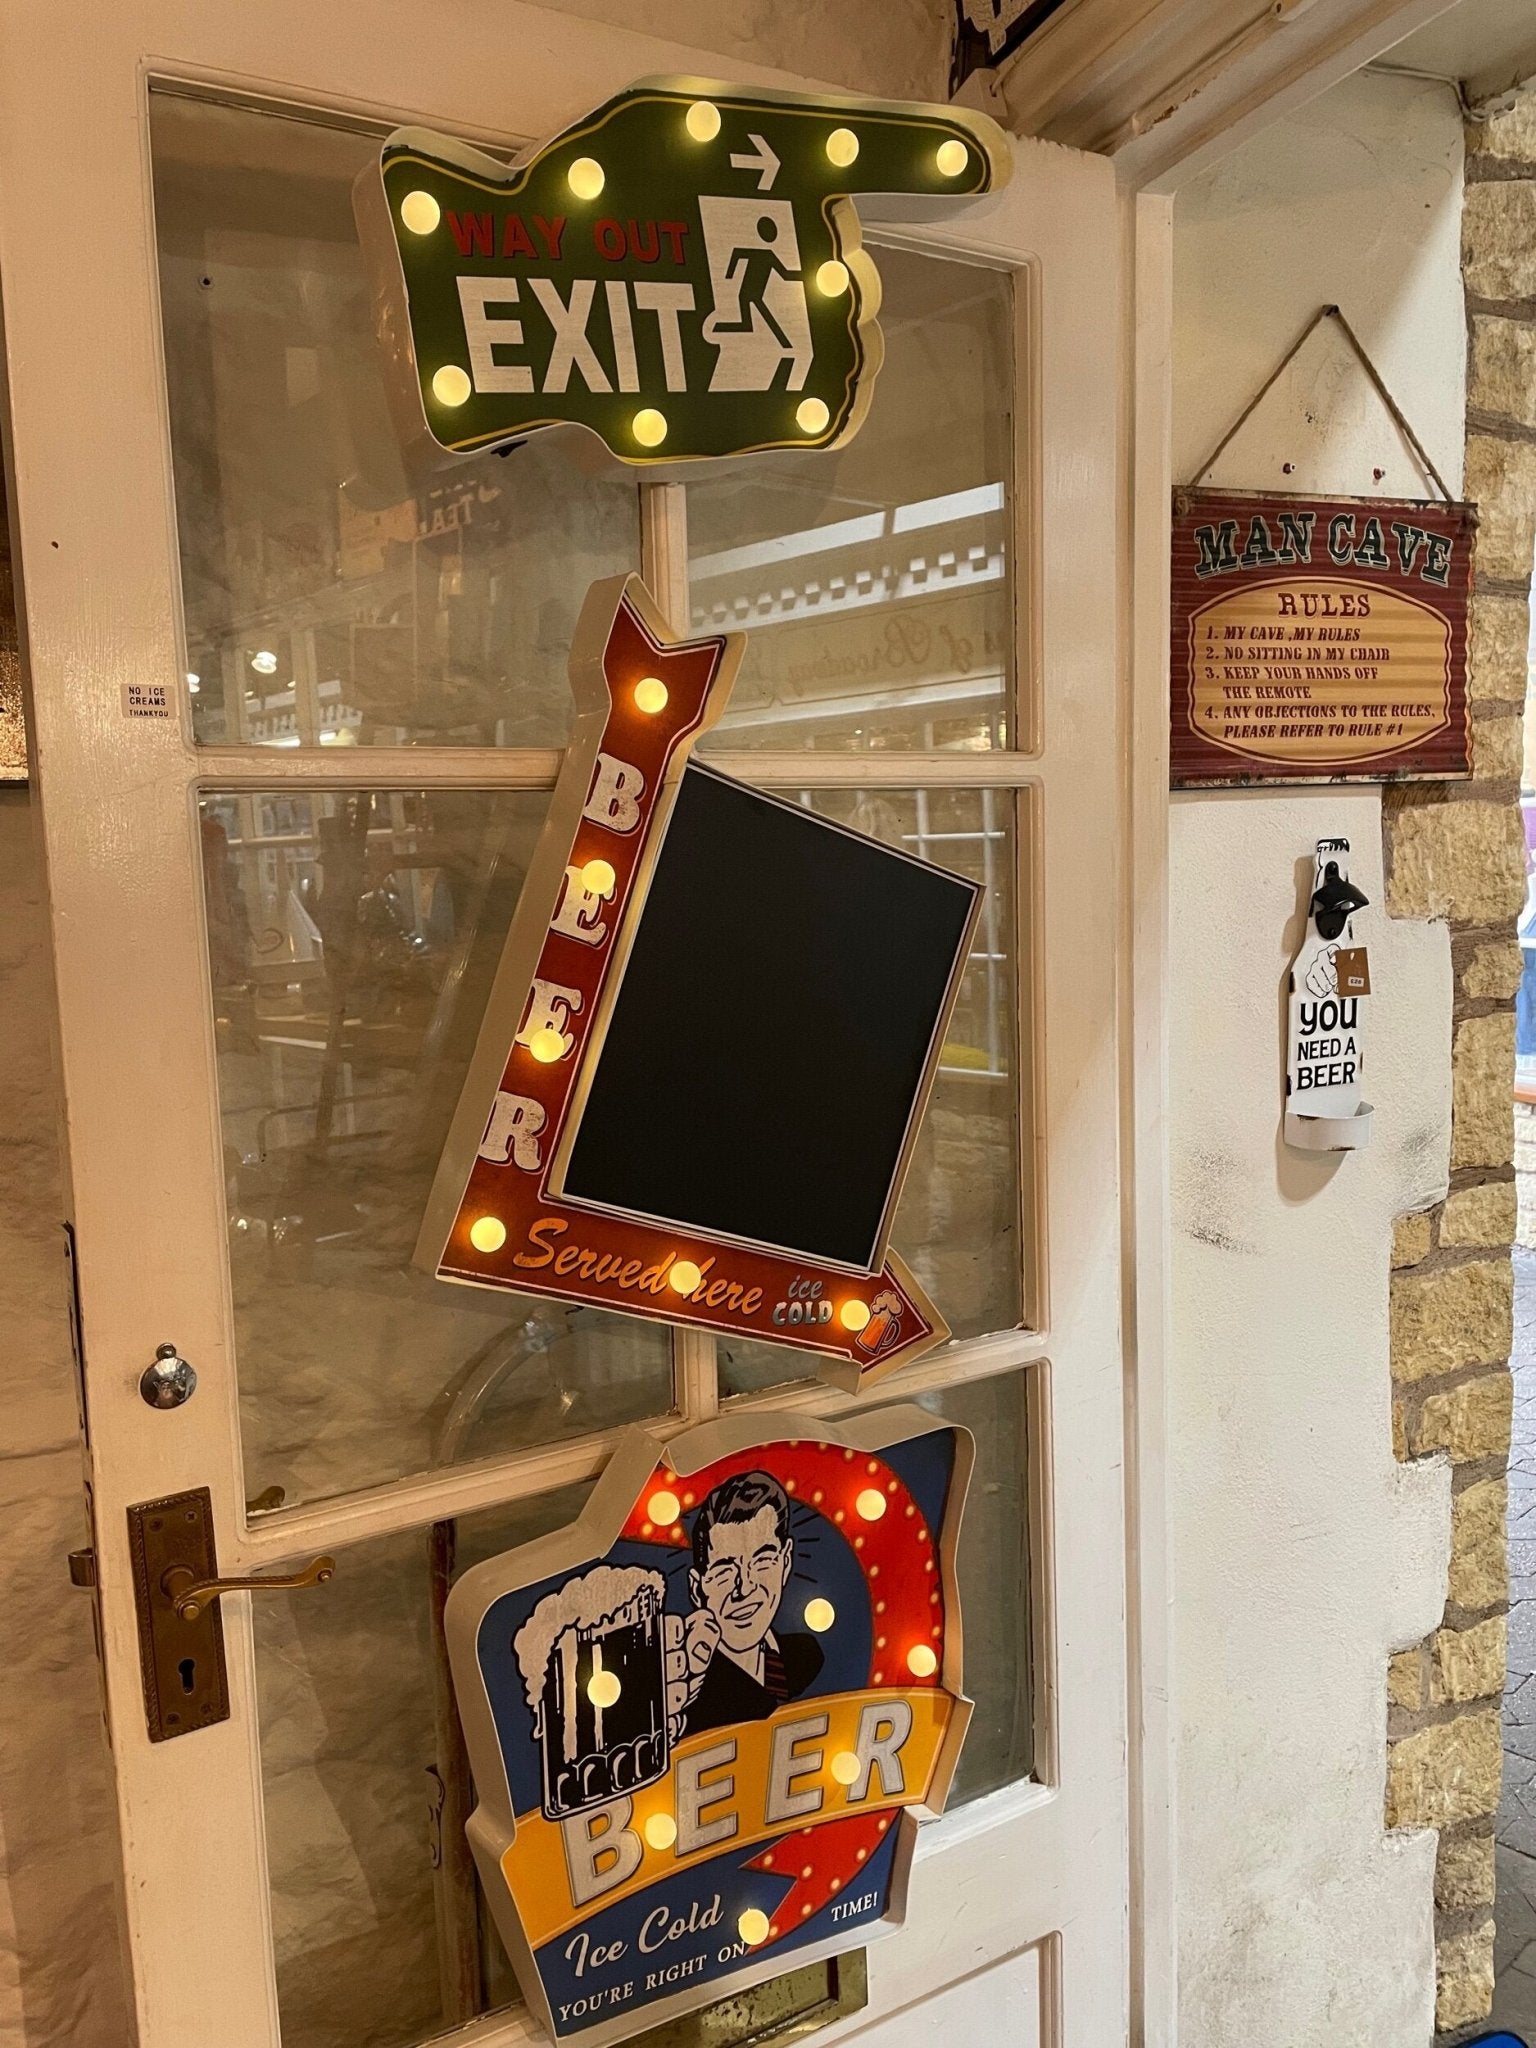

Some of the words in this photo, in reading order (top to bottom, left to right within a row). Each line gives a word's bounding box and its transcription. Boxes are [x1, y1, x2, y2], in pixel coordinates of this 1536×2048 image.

[446, 210, 566, 260] WAY
[593, 217, 690, 265] OUT
[457, 275, 697, 393] EXIT
[1194, 512, 1316, 580] MAN
[1327, 513, 1453, 588] CAVE
[1278, 592, 1371, 617] RULES
[1207, 626, 1219, 640] 1.
[1223, 626, 1246, 640] MY
[1318, 627, 1361, 641] RULES
[1205, 646, 1219, 659] 2.
[1224, 646, 1243, 660] NO
[1248, 647, 1302, 660] SITTING
[1307, 647, 1321, 660] IN
[1326, 647, 1345, 660] MY
[1350, 648, 1390, 660] CHAIR
[1205, 667, 1219, 679] 3.
[1223, 666, 1260, 679] KEEP
[1264, 667, 1302, 679] YOUR
[1305, 667, 1351, 680] HANDS
[1354, 667, 1378, 679] OFF
[128, 686, 141, 695] NO
[148, 687, 165, 696] ICE
[129, 696, 166, 706] CREAMS
[1223, 686, 1252, 698] THE
[1255, 686, 1312, 698] REMOTE
[1204, 706, 1218, 719] 4.
[1223, 706, 1252, 718] ANY
[1254, 705, 1337, 718] OBJECTIONS
[1340, 705, 1358, 718] TO
[1361, 704, 1388, 718] THE
[1391, 704, 1435, 718] RULES,
[1223, 725, 1277, 738] PLEASE
[1279, 724, 1324, 738] REFER
[1327, 724, 1345, 737] TO
[1348, 723, 1383, 737] RULE
[1297, 1038, 1341, 1061] NEED
[1344, 1036, 1357, 1056] A
[1296, 1061, 1356, 1091] BEER
[513, 1217, 678, 1295] Served
[787, 1274, 824, 1299] ice
[772, 1299, 834, 1327] COLD
[560, 1699, 914, 1909] BEER
[564, 1933, 629, 1978] Ice
[638, 1893, 724, 1956] Cold
[558, 1980, 635, 2023] YOU'RE
[645, 1954, 707, 1992] RIGHT
[717, 1940, 748, 1965] ON
[831, 1891, 878, 1923] TIME!
